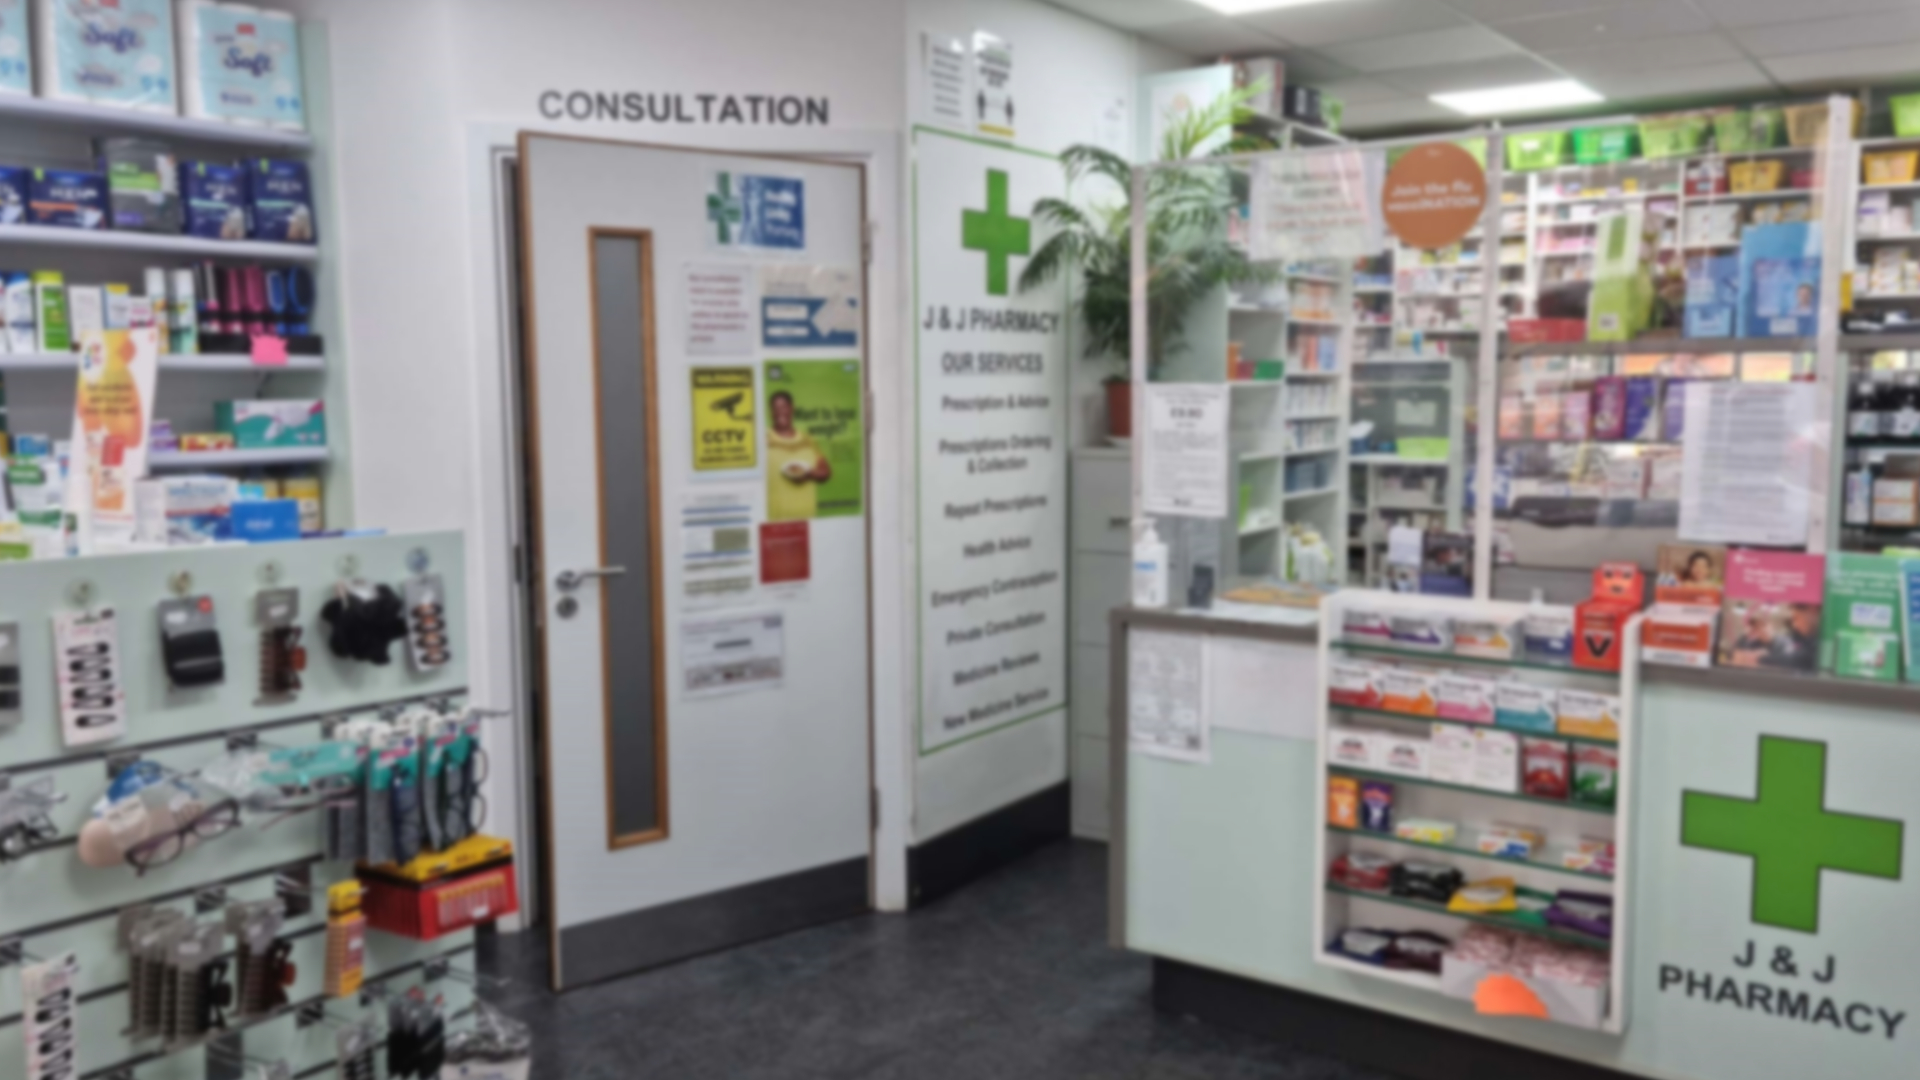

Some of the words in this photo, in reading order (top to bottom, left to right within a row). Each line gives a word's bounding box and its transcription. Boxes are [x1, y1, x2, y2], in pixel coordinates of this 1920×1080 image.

[222, 46, 275, 78] Soft
[538, 90, 829, 126] CONSULTATION
[1391, 185, 1421, 198] Join
[1425, 182, 1448, 194] the
[1452, 179, 1473, 194] flu
[923, 306, 935, 330] J
[938, 306, 951, 331] &
[956, 308, 967, 331] J
[970, 307, 1060, 335] PHARMACY
[941, 352, 973, 373] OUR
[977, 352, 1043, 374] SERVICES
[942, 395, 1004, 412] Prescription
[1007, 394, 1015, 409] &
[1018, 395, 1050, 409] Advice
[702, 429, 746, 445] CCTV
[939, 439, 1008, 455] Prescriptions
[1010, 435, 1052, 451] Ordering
[967, 458, 976, 474] &
[978, 456, 1028, 473] Collection
[931, 586, 989, 608] Emergency
[992, 570, 1058, 595] Contraception
[946, 628, 983, 645] Private
[985, 611, 1046, 636] Consultation
[1733, 939, 1755, 968] J
[1770, 945, 1799, 978] &
[1812, 954, 1835, 984] J
[1659, 963, 1907, 1040] PHARMACY
